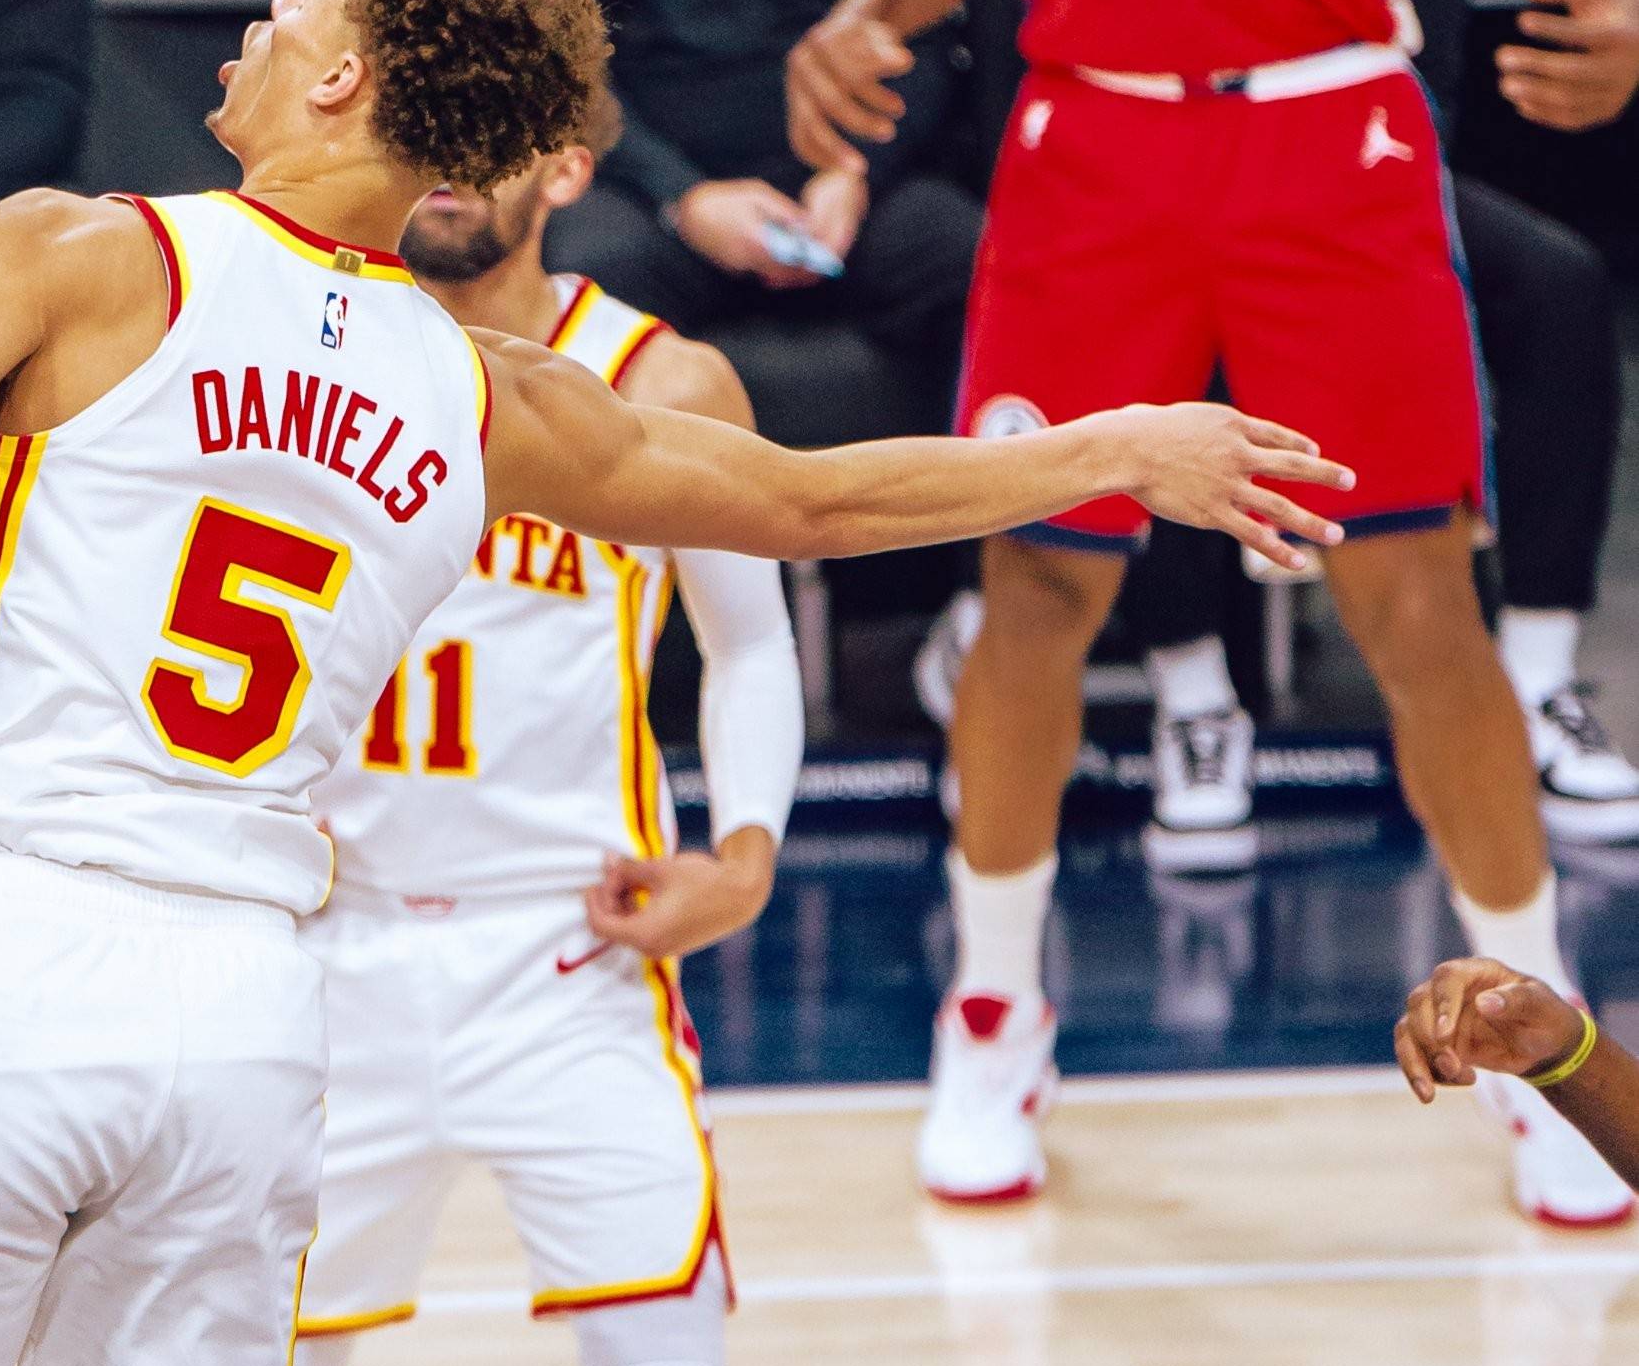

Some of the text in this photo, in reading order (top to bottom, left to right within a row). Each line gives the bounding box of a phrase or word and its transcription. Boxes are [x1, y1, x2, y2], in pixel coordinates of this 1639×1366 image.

[191, 366, 448, 524] DANIELS
[140, 495, 353, 779] 5
[362, 638, 477, 777] 11
